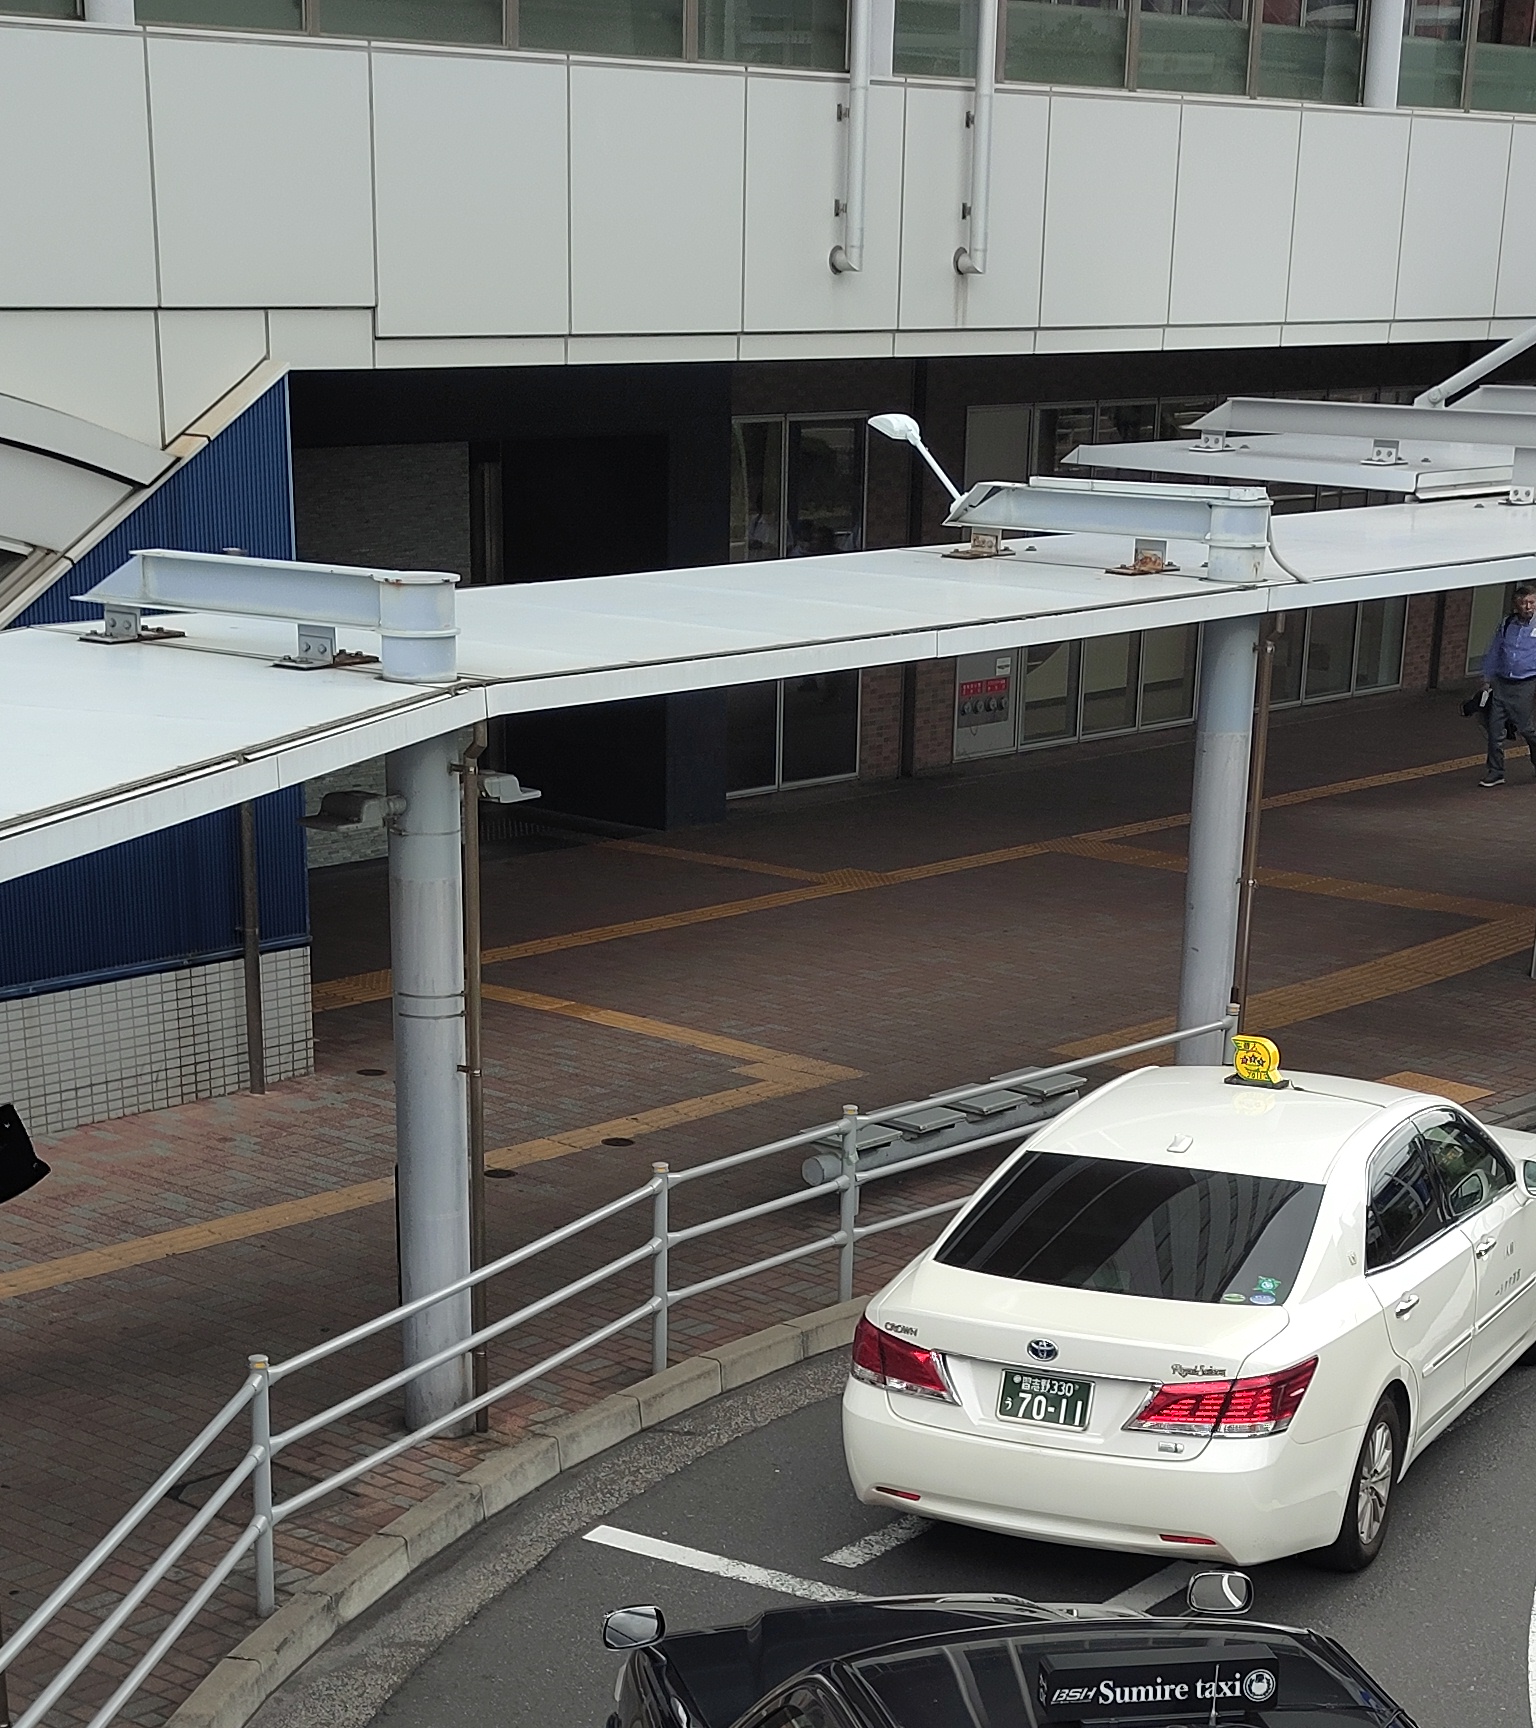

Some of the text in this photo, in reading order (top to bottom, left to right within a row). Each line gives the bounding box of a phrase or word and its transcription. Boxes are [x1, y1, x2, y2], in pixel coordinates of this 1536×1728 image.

[885, 1322, 918, 1336] CROWN
[1021, 1377, 1074, 1397] 習志野330
[1017, 1392, 1083, 1426] 70-11
[1098, 1677, 1190, 1705] Sumire
[1195, 1673, 1242, 1699] taxi
